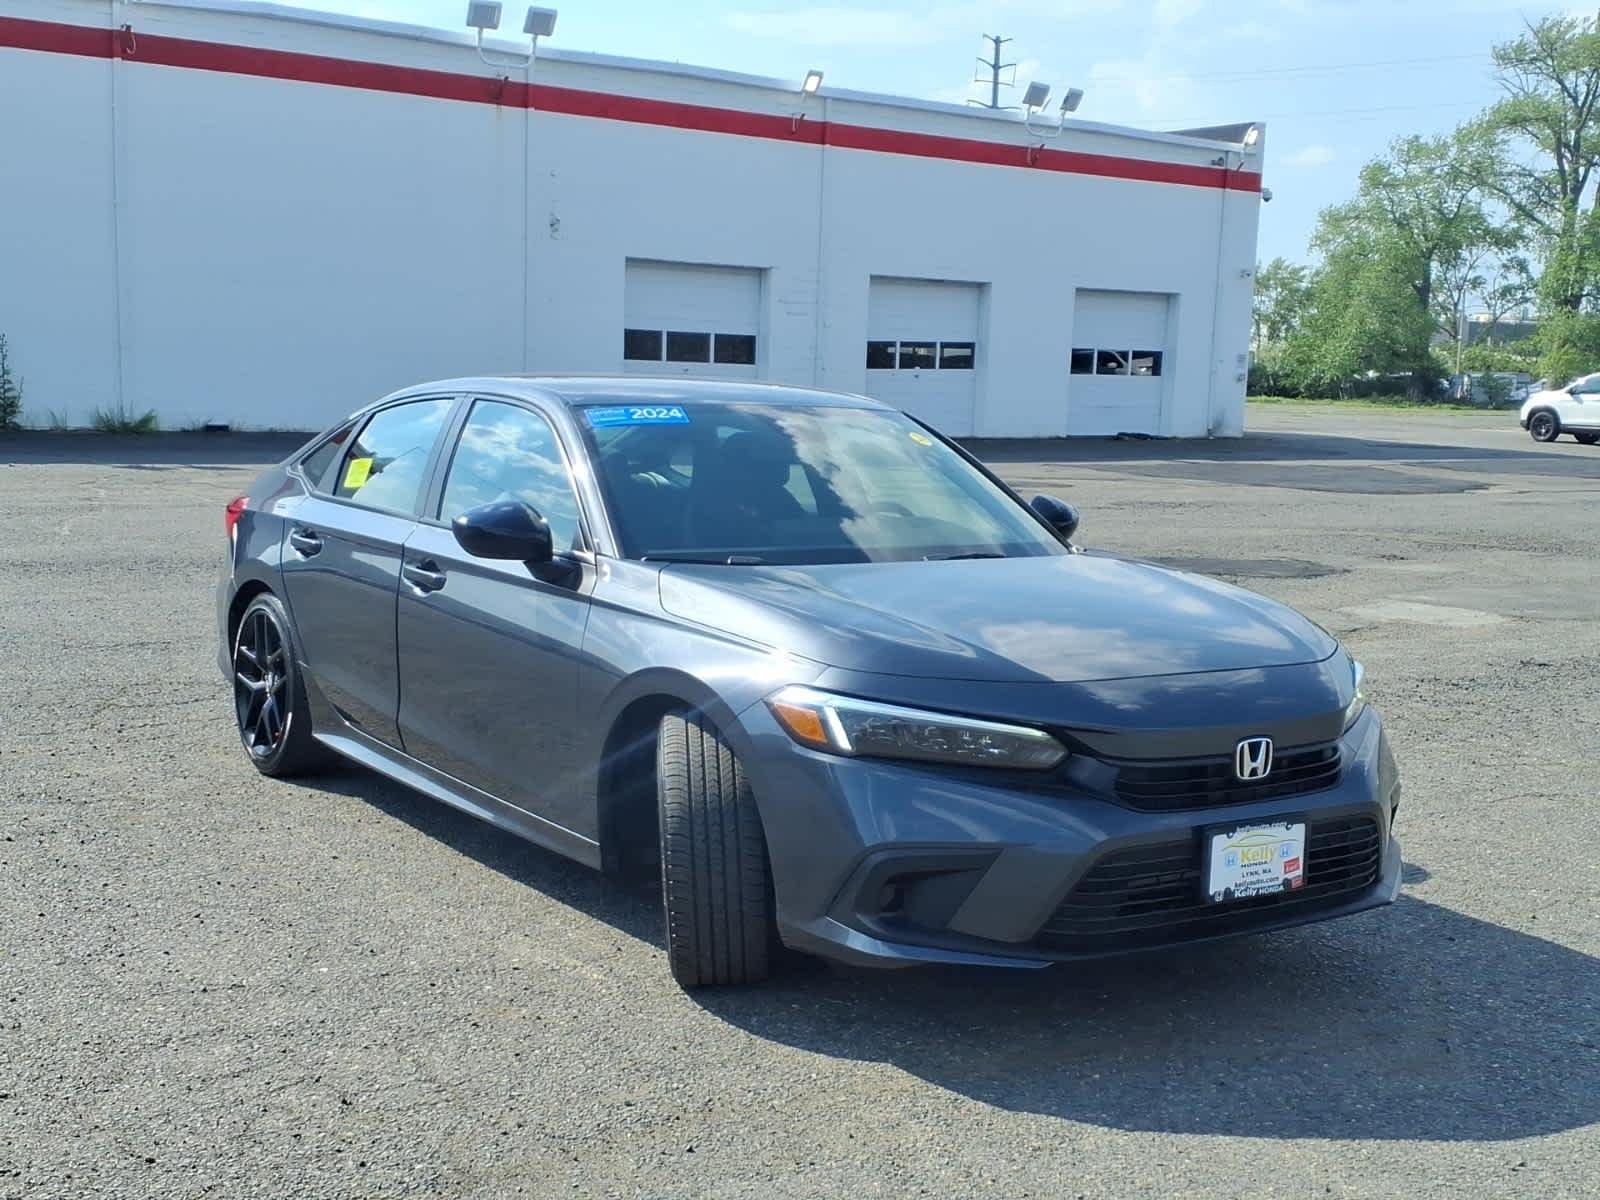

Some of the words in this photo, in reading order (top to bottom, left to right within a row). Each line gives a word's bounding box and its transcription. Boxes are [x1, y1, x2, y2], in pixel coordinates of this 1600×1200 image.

[629, 407, 683, 419] 2024
[1241, 846, 1274, 862] Kelly
[1241, 860, 1268, 868] HONDA
[1234, 887, 1257, 898] Kelly
[1259, 884, 1284, 895] HONDA
